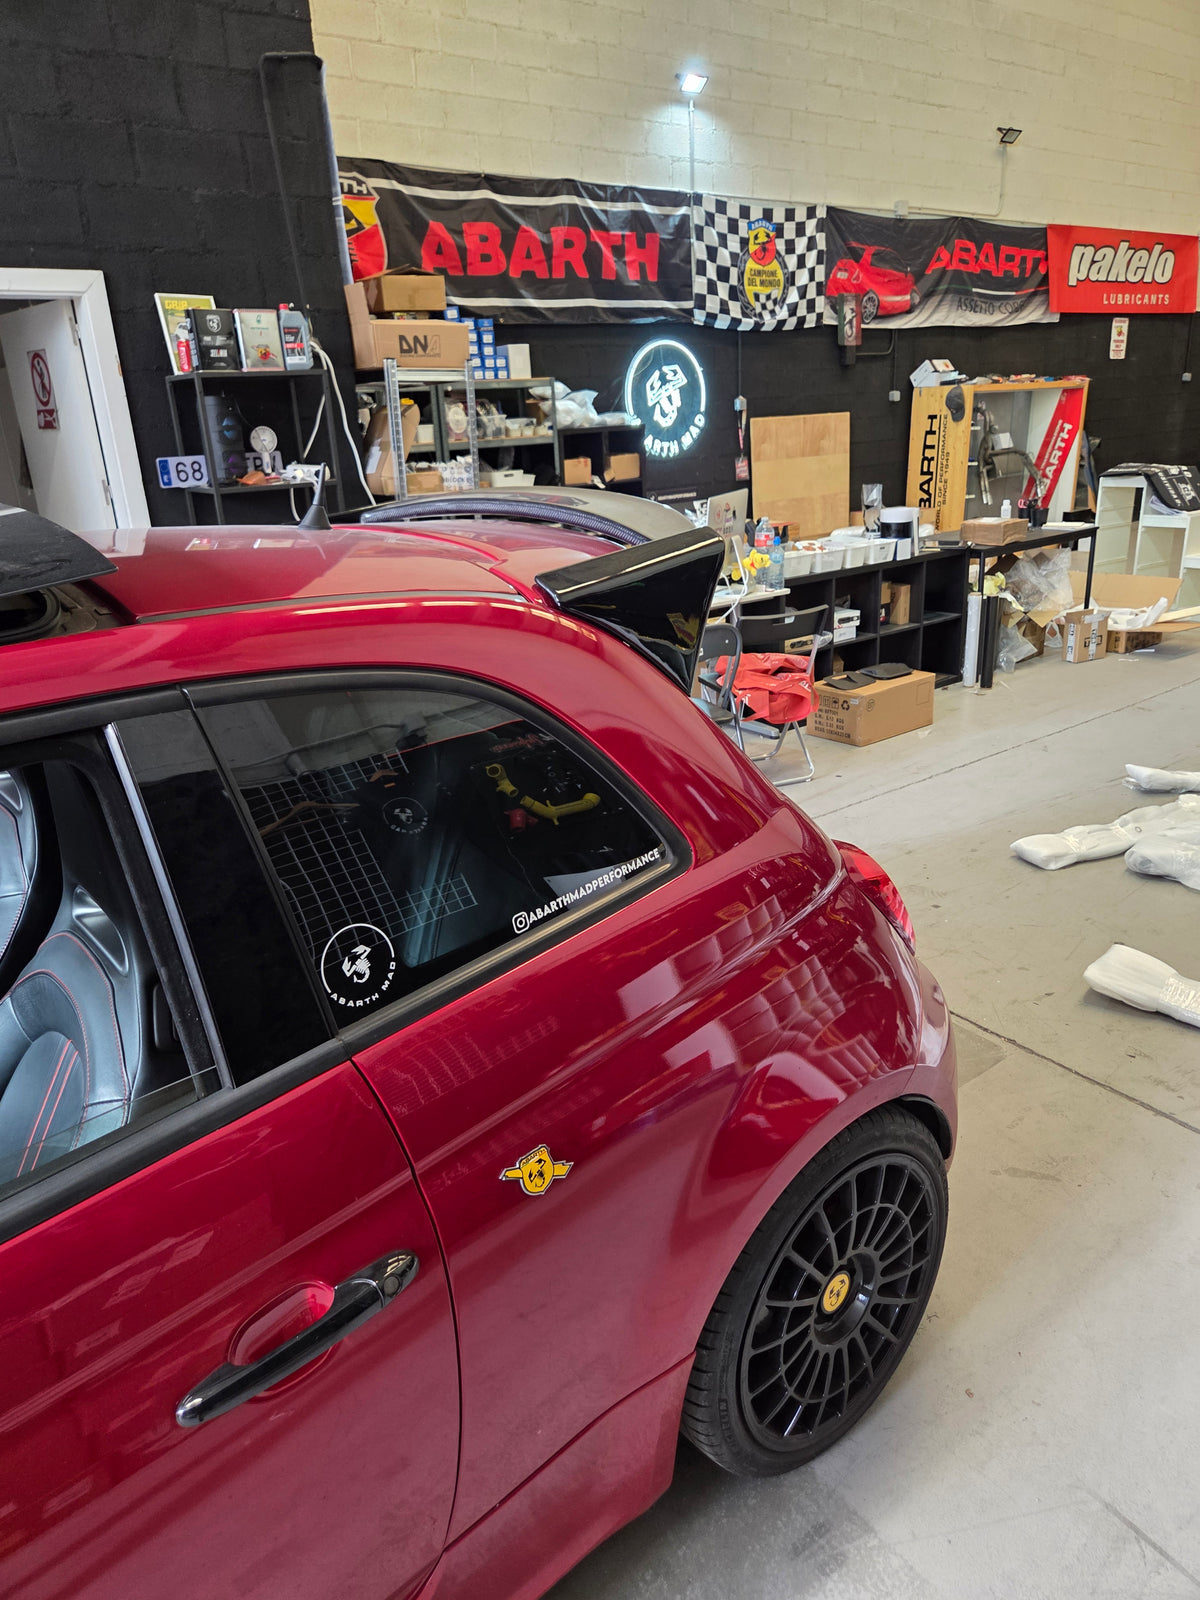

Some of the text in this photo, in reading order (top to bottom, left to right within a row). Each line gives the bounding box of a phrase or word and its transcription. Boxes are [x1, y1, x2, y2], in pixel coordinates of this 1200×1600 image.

[421, 220, 660, 282] ABARTH
[749, 268, 778, 278] CAMPIONE
[1067, 240, 1176, 287] pakelo
[747, 277, 781, 288] DEL MONDO
[957, 297, 995, 315] ASSETTO
[1103, 293, 1170, 305] LUBRICANTS
[175, 461, 204, 482] 68
[918, 414, 938, 508] BARTH
[938, 414, 949, 484] PERFORMANCE
[529, 848, 660, 924] ABARTHMADPERFORMANCE
[330, 961, 396, 1008] ABARTH MAD
